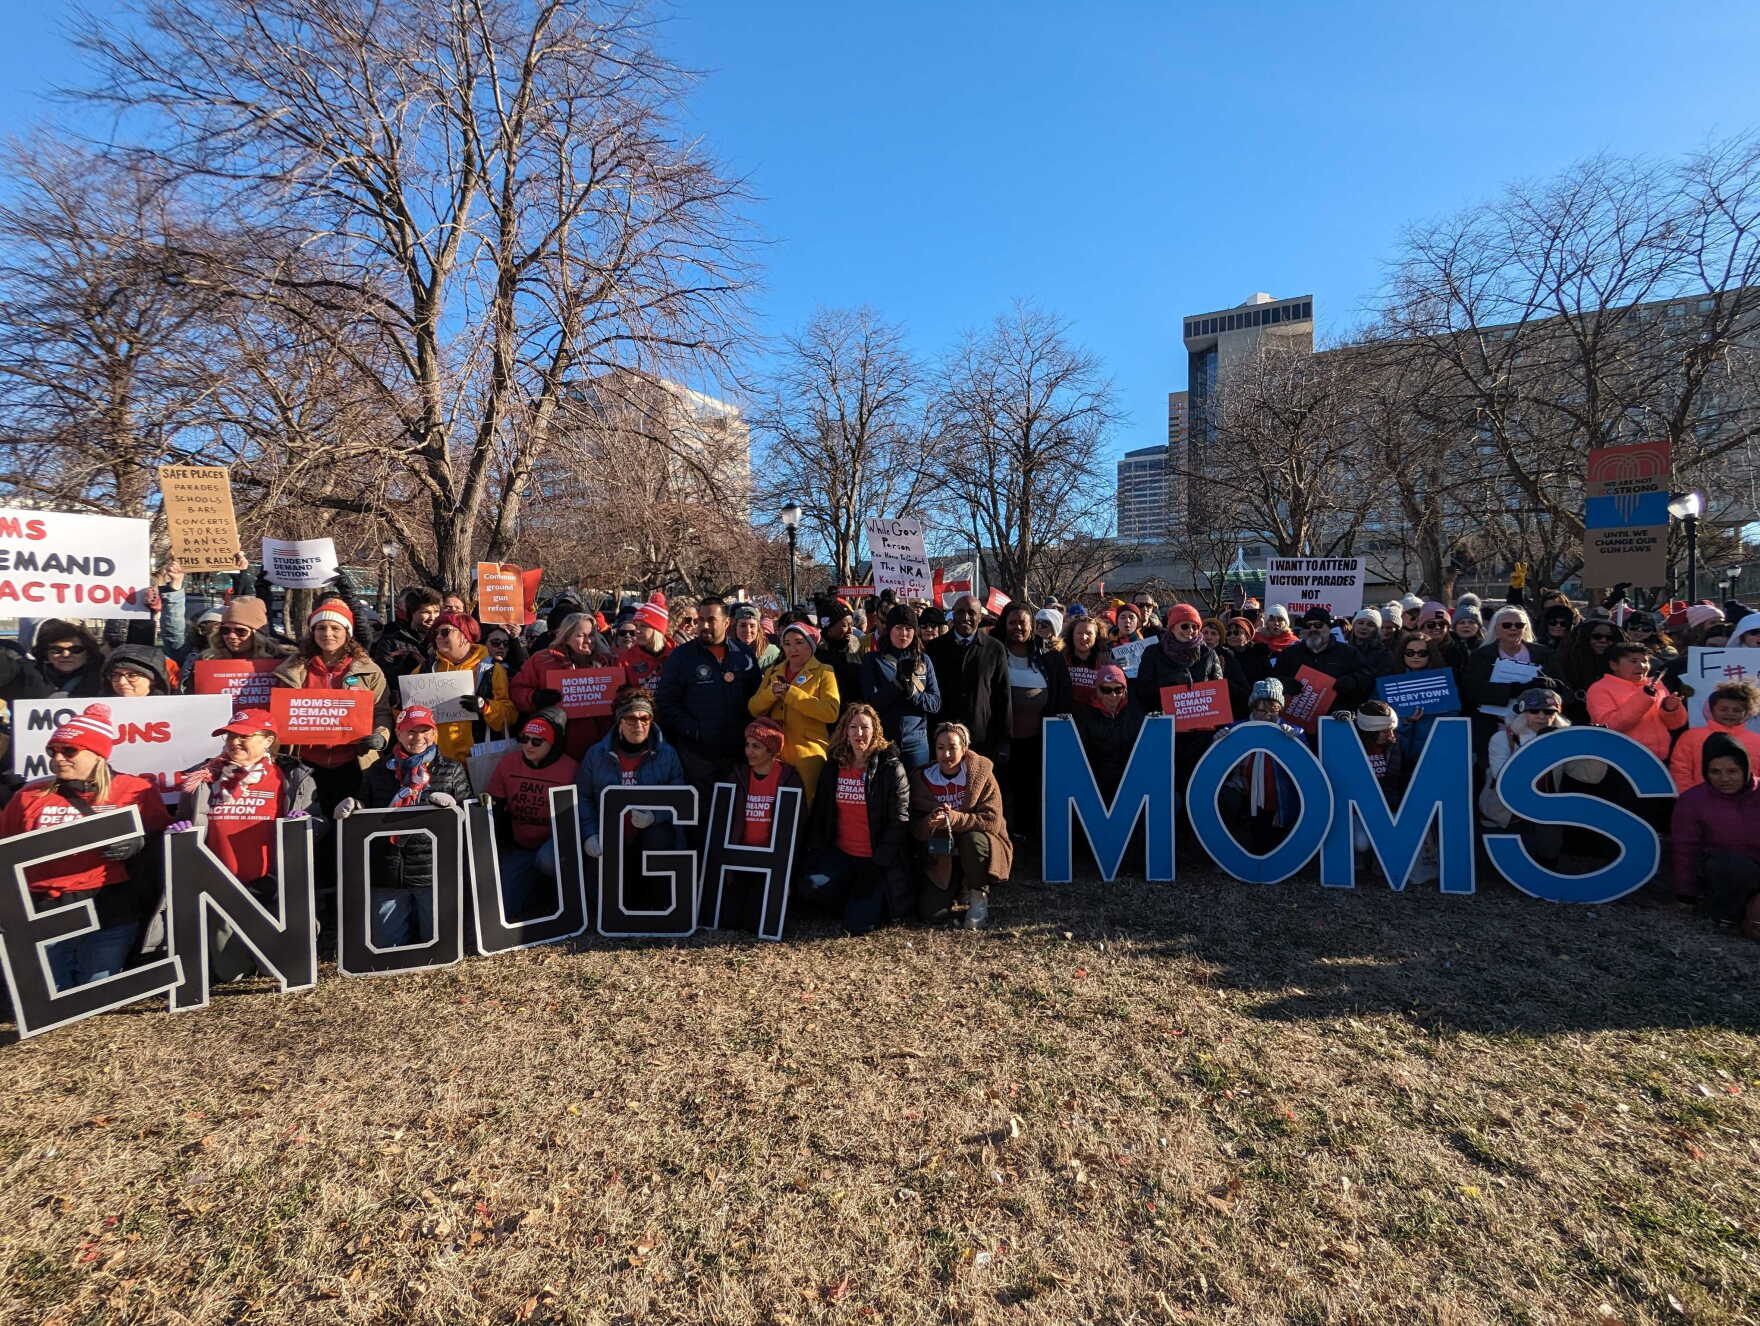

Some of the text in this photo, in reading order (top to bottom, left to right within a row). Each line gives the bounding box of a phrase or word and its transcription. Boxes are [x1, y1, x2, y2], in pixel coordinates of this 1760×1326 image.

[162, 469, 224, 479] SAFE PLACES
[175, 495, 222, 504] SCHOOLS
[188, 506, 217, 514] BARS
[175, 518, 230, 526] CONCERTS
[0, 517, 47, 541] MS
[183, 526, 228, 536] STORES
[1632, 529, 1648, 537] WE
[183, 536, 228, 546] BANKS
[1594, 538, 1633, 546] CHANGE
[1600, 545, 1651, 554] GUN LAWS
[0, 549, 116, 576] EMAND
[176, 557, 200, 565] THIS
[1270, 559, 1358, 571] I WANT TO ATTEND
[880, 562, 895, 572] The
[1269, 575, 1356, 586] VICTORY PARADES
[0, 580, 137, 605] ACTION
[486, 584, 514, 593] ground
[1301, 589, 1321, 600] NOT
[562, 676, 594, 686] MOMS
[221, 686, 270, 696] EMAND
[562, 684, 607, 694] DEMAND
[563, 692, 601, 702] ACTION
[1172, 690, 1201, 701] MOMS
[1387, 689, 1450, 703] EVERYTOWN
[290, 698, 332, 708] MOMS
[1174, 696, 1213, 708] DEMAND
[289, 707, 349, 717] DEMAND
[1176, 704, 1209, 715] ACTION
[27, 709, 78, 730] MO
[288, 716, 340, 726] ACTION
[520, 782, 544, 793] BAN
[42, 806, 81, 815] MOM
[745, 809, 765, 817] TION
[1040, 715, 1679, 904] MOMS
[0, 782, 803, 1039] ENOUGH
